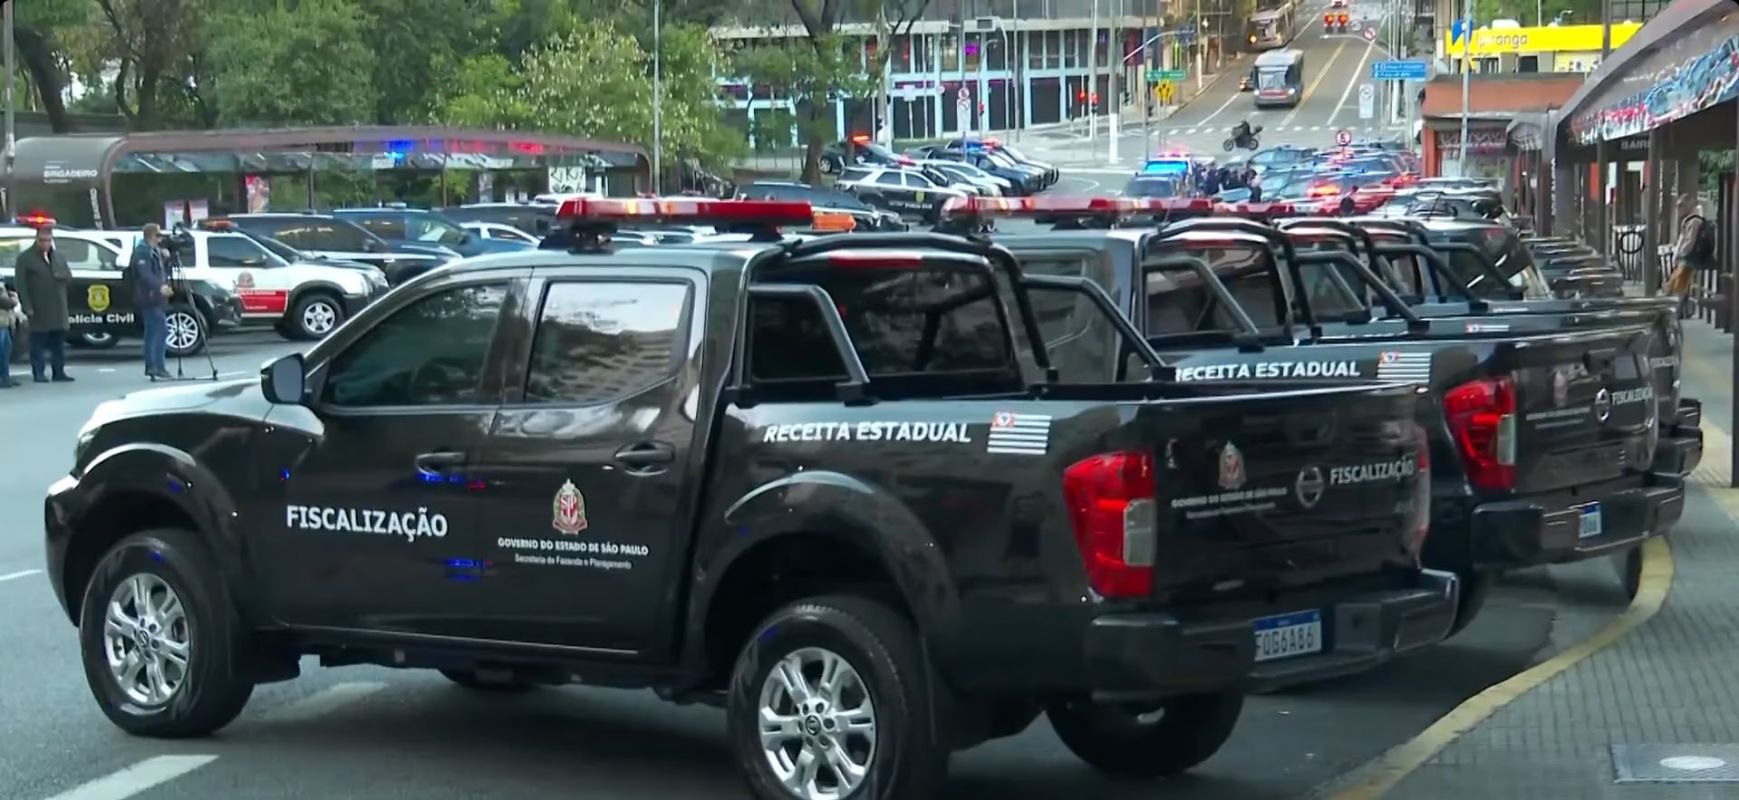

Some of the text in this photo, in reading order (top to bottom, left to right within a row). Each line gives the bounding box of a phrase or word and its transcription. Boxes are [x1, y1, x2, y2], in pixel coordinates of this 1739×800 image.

[106, 313, 135, 323] Civil
[1255, 361, 1361, 379] ESTADUAL
[763, 422, 972, 443] RECEITA ESTADUAL
[286, 505, 449, 542] FISCALIZAÇÃO
[497, 537, 649, 556] GOVERNO DO ESTADO DE SÃO PAULO
